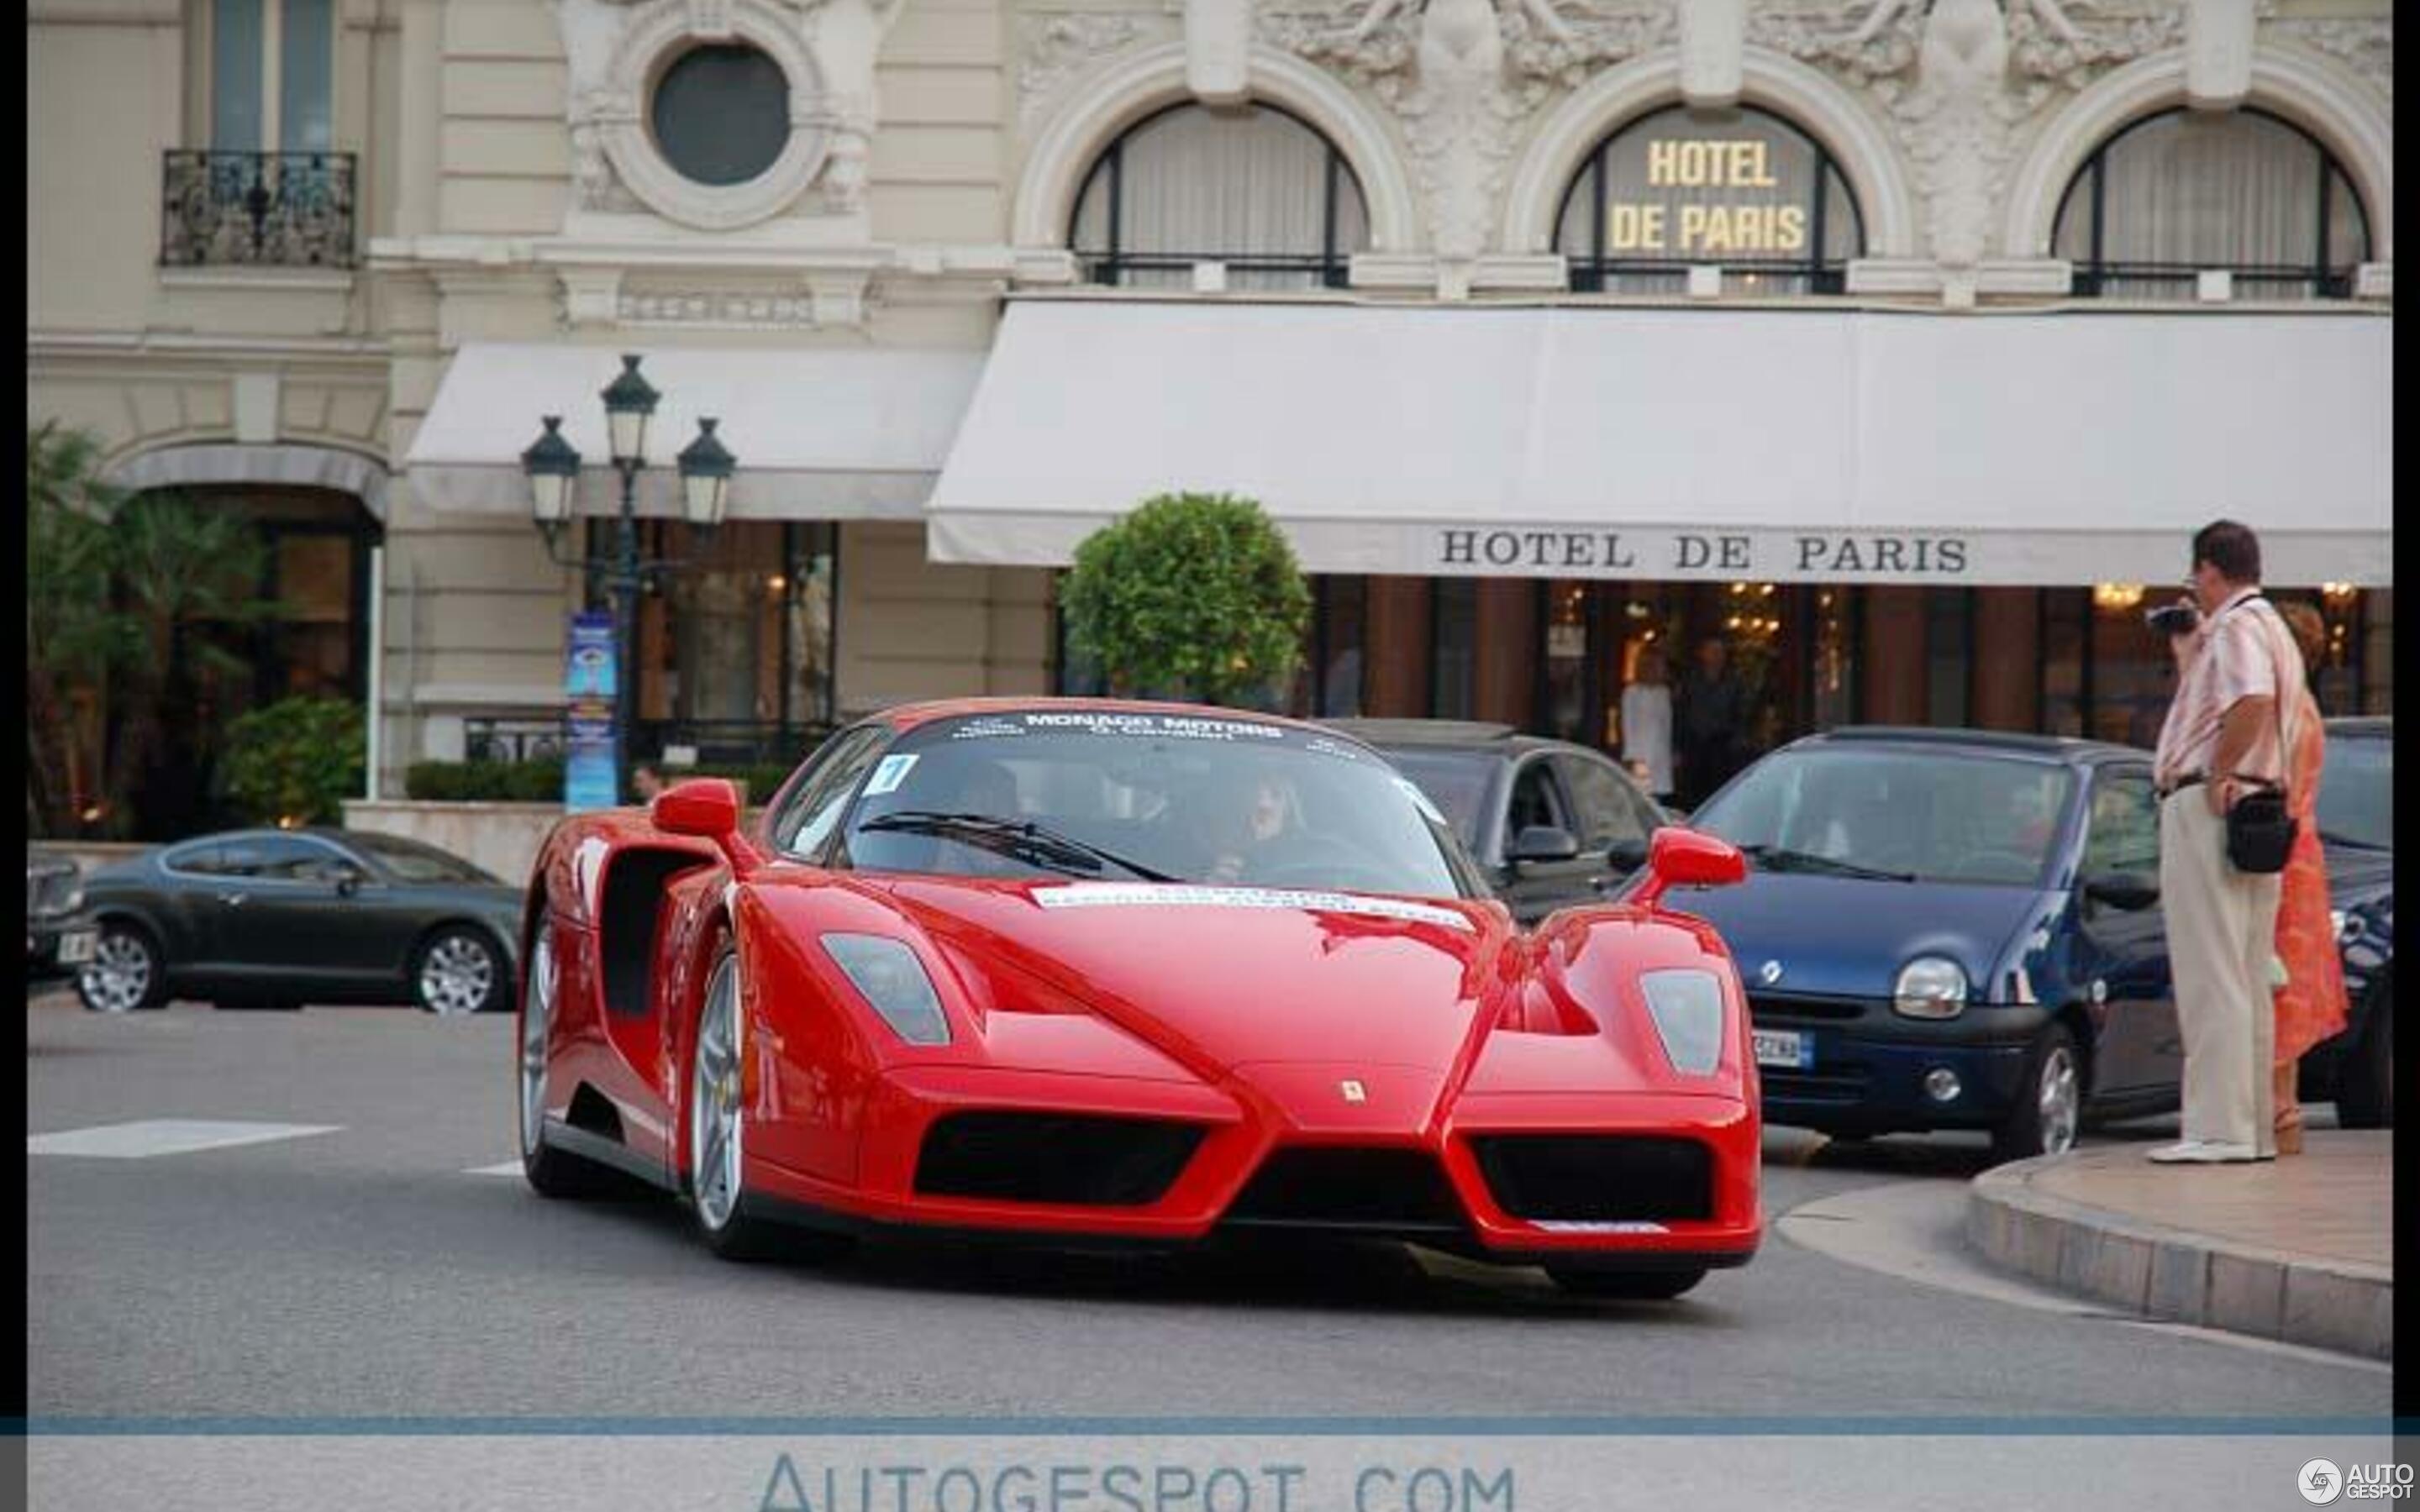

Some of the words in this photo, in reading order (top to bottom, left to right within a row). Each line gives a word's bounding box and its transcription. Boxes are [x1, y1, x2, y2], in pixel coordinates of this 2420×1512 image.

[1649, 140, 1777, 186] HOTEL
[1612, 206, 1665, 249] DE
[1681, 206, 1805, 249] PARIS
[1441, 531, 1634, 568] HOTEL
[1673, 535, 1751, 570] DE
[1796, 537, 1967, 573] PARIS
[1025, 714, 1154, 727] MONACO
[1164, 717, 1283, 738] MOTORS
